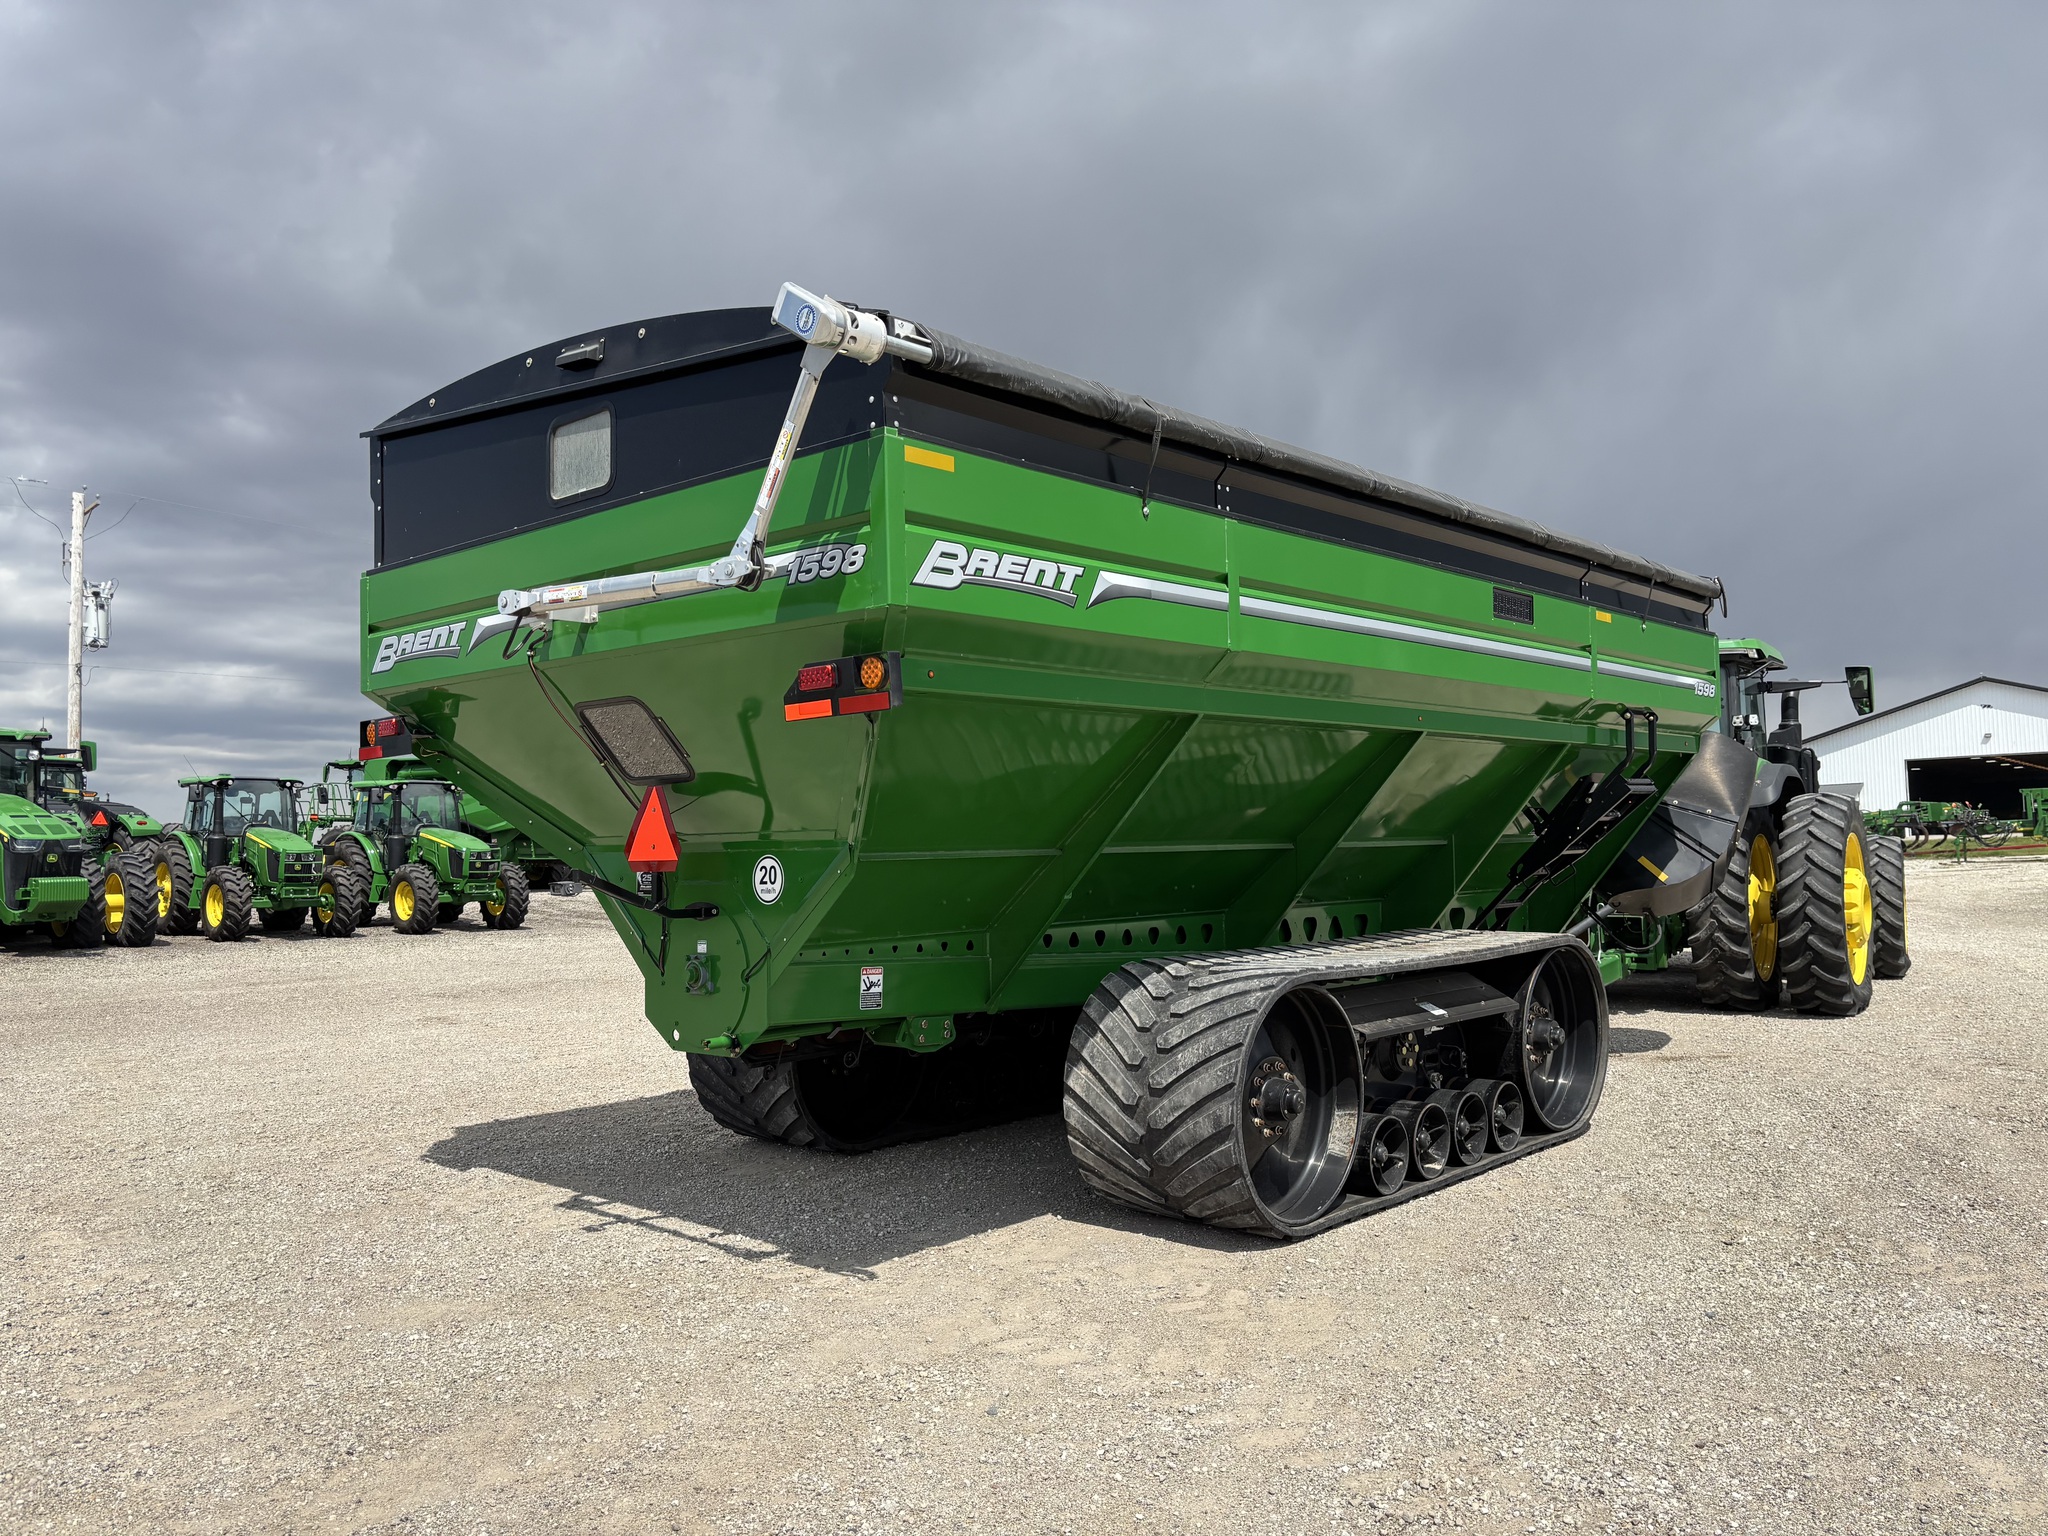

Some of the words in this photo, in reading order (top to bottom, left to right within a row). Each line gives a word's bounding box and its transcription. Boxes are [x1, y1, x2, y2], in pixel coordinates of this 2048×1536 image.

[787, 543, 867, 586] 1598
[911, 539, 1085, 593] BRENT
[371, 621, 467, 674] BRENT
[1694, 682, 1716, 698] 1598
[759, 865, 777, 885] 20
